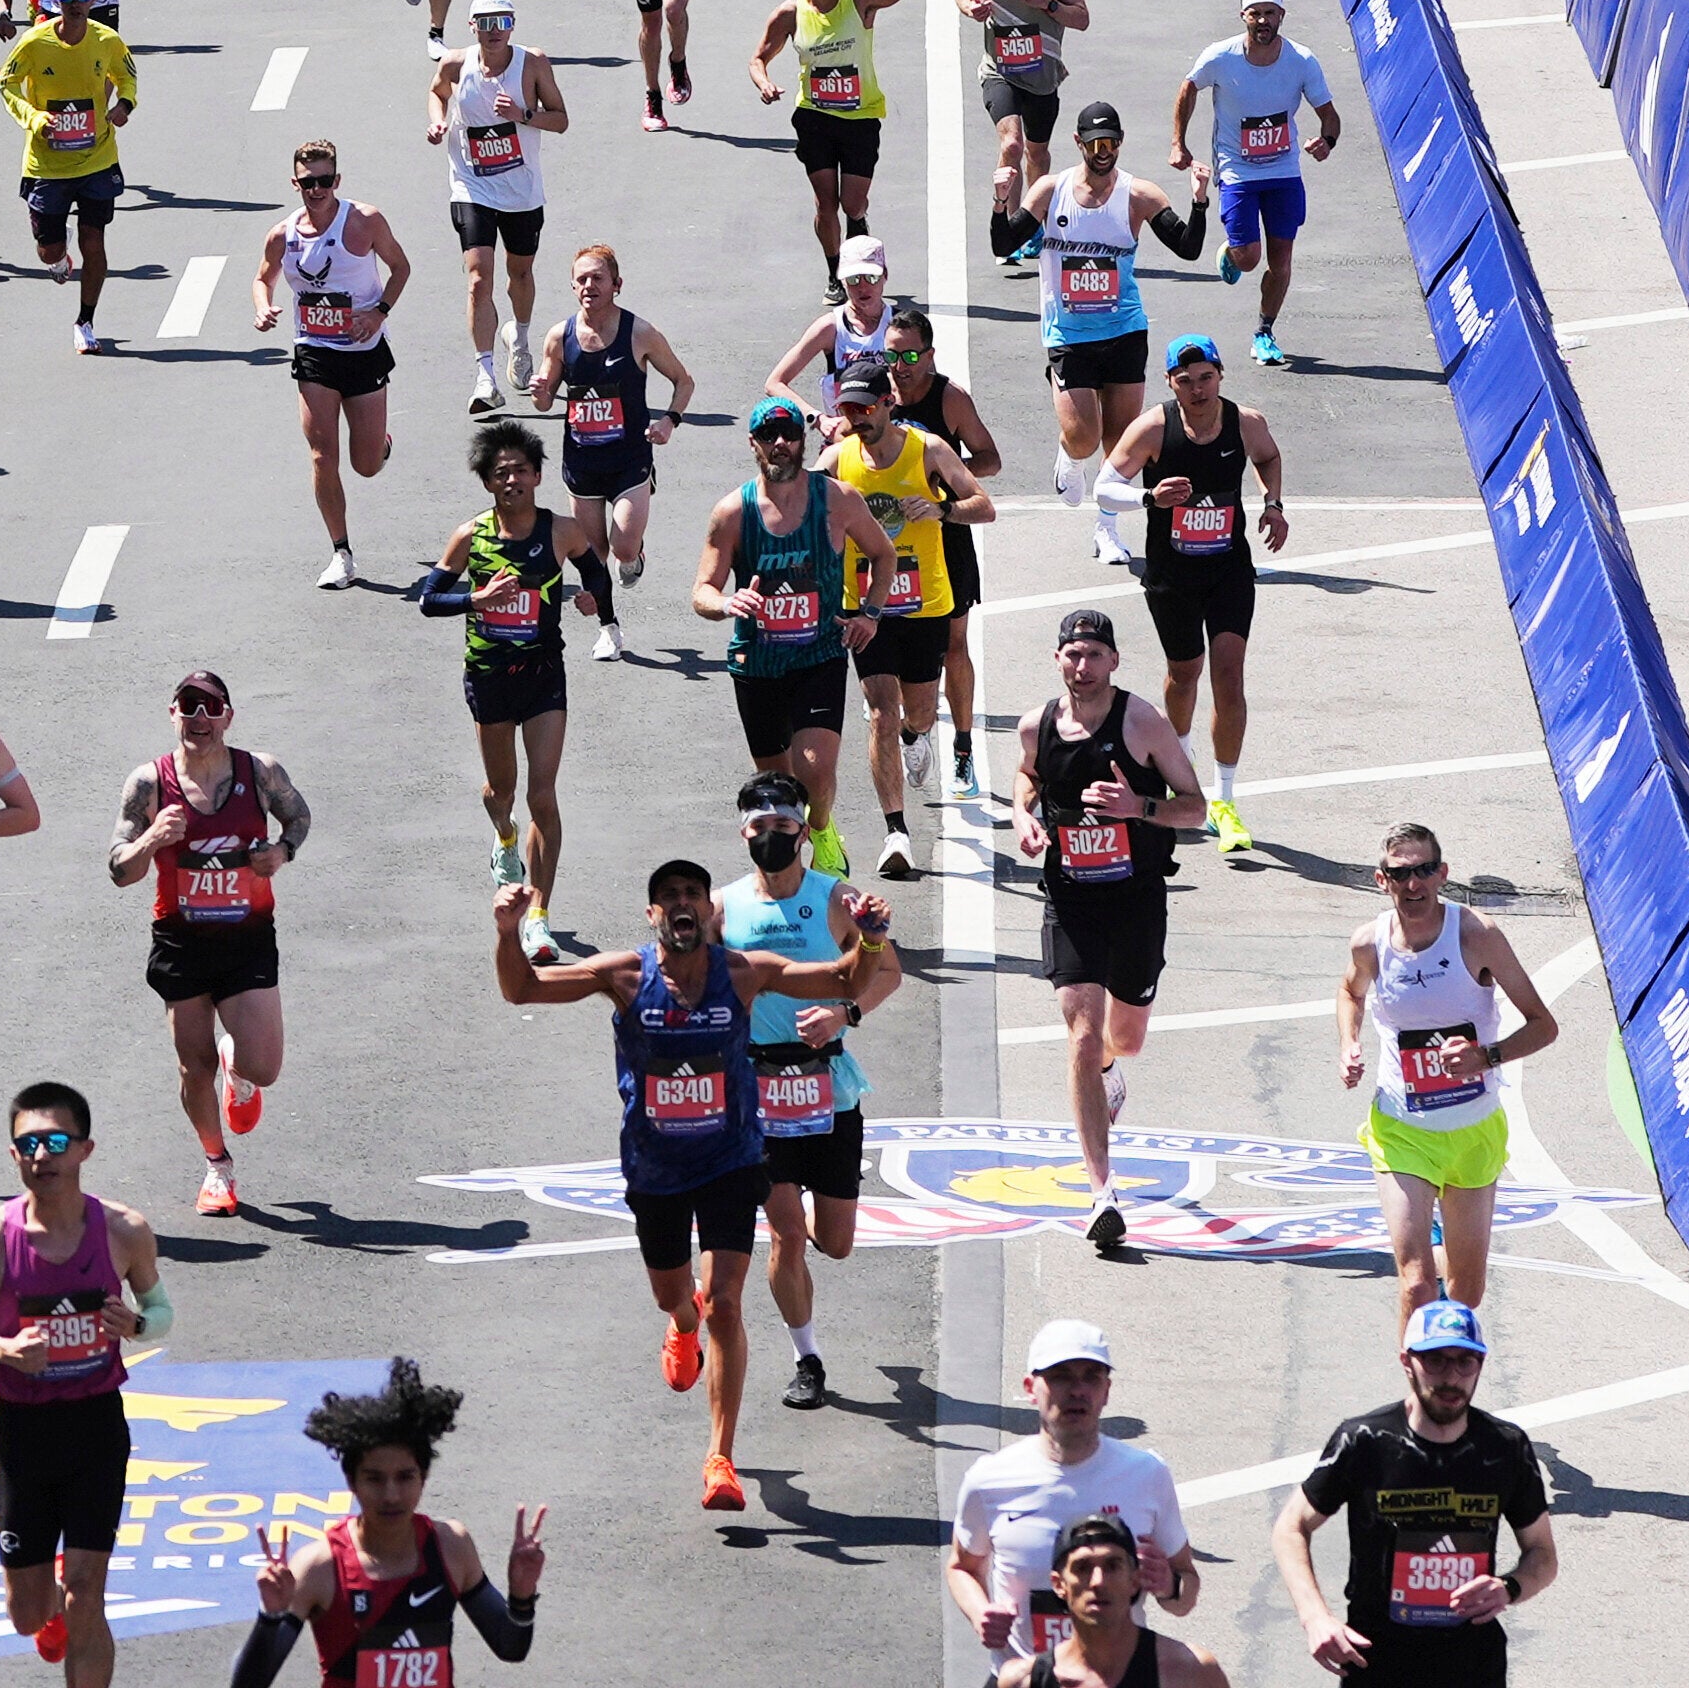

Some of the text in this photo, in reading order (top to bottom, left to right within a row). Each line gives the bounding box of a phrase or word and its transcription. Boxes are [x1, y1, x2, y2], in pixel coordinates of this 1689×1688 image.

[1001, 38, 1035, 56] 5450
[818, 77, 853, 96] 3615
[476, 138, 512, 157] 3068
[1249, 127, 1283, 148] 6317
[1069, 272, 1109, 293] 6483
[306, 307, 344, 327] 5234
[1181, 508, 1227, 532] 4805
[763, 595, 809, 621] 4273
[1067, 827, 1118, 856] 5022
[188, 870, 239, 896] 7412
[1412, 1050, 1444, 1080] 13
[656, 1076, 714, 1105] 6340
[766, 1077, 822, 1107] 4466
[1225, 1141, 1363, 1163] DAY
[1378, 1491, 1496, 1513] MIDNIGHT HALF
[1407, 1554, 1475, 1591] 3339
[1043, 1614, 1074, 1647] 59
[373, 1650, 438, 1688] 1782
